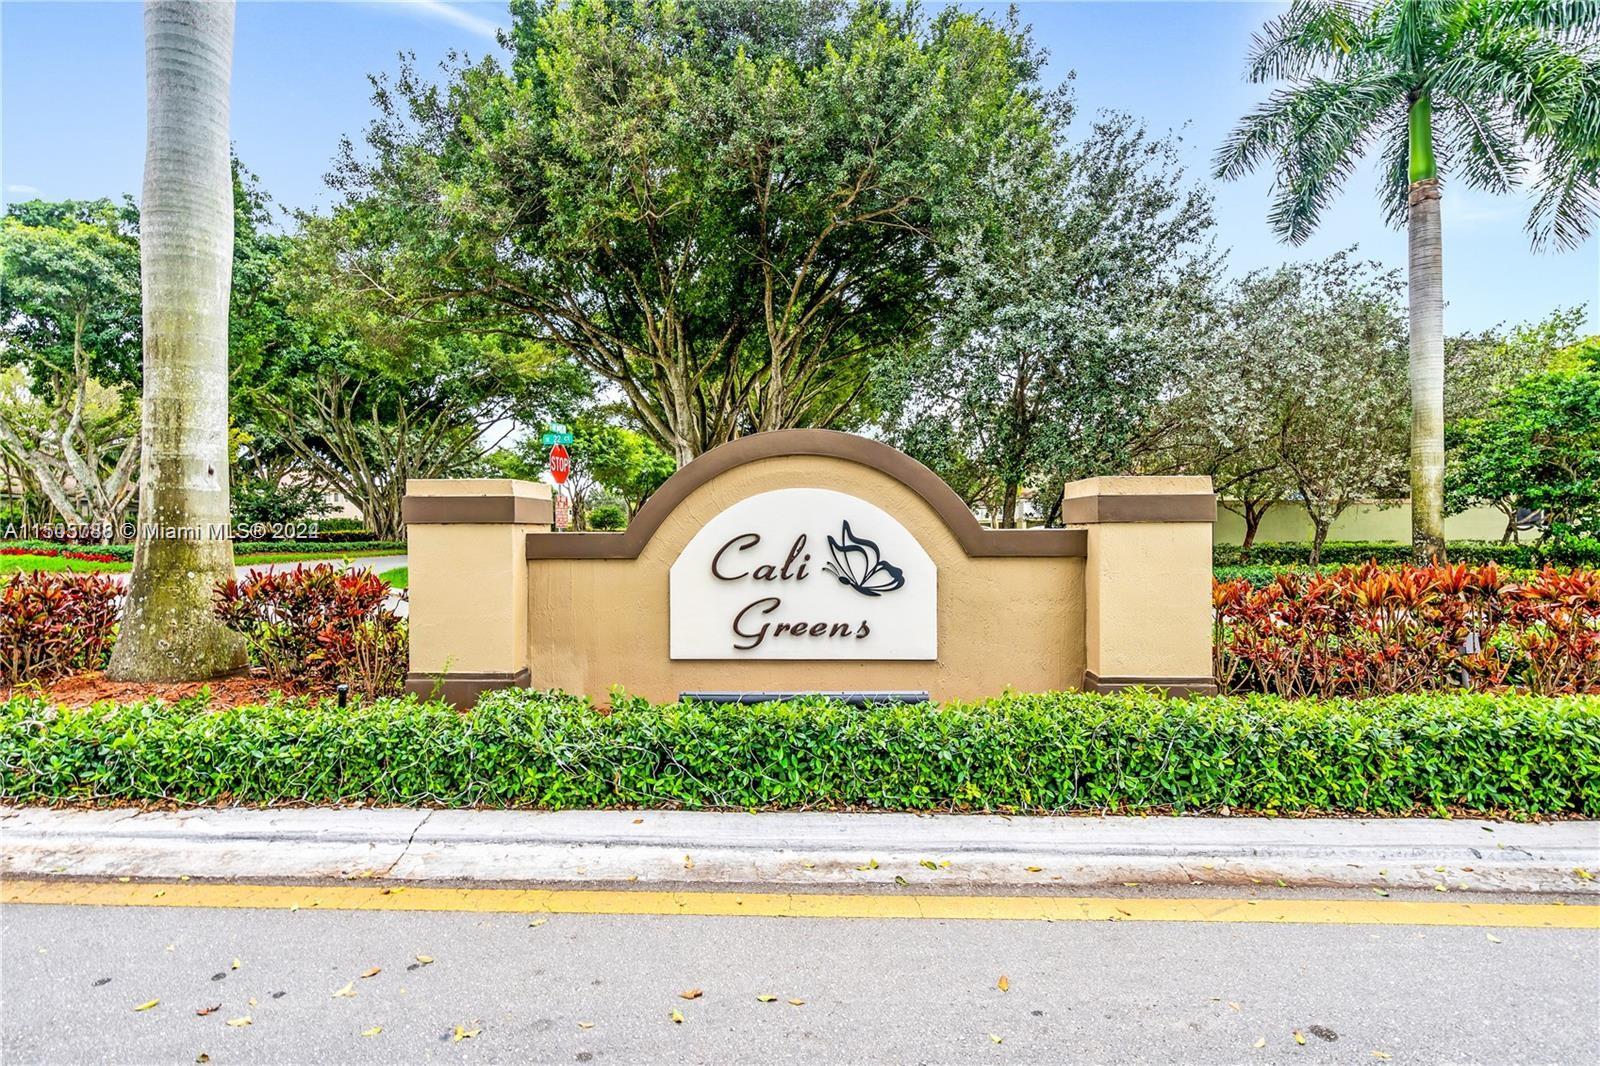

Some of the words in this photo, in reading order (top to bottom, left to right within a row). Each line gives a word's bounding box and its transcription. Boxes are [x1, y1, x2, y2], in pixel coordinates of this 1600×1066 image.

[551, 456, 570, 472] STOP
[711, 533, 811, 581] Cali
[732, 597, 872, 650] Greens
